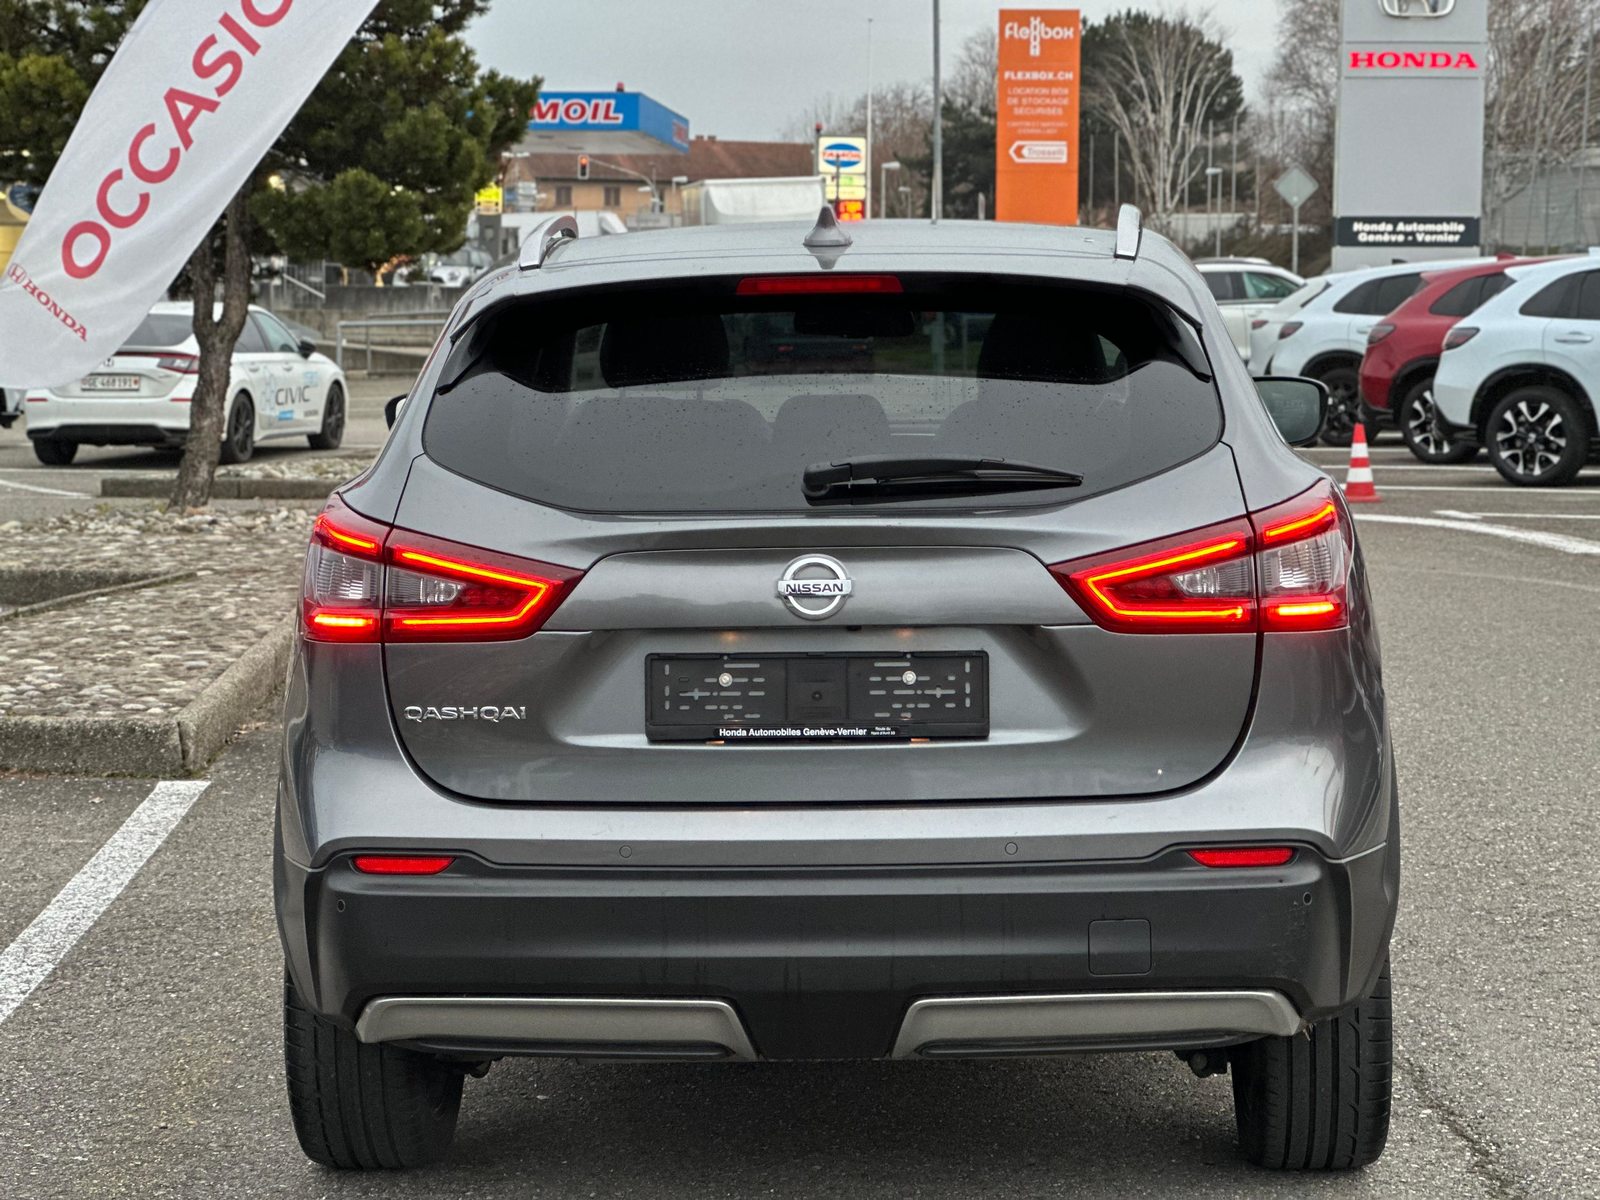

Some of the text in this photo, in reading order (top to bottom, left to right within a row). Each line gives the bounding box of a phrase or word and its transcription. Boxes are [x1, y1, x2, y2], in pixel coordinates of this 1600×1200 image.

[1349, 51, 1478, 70] HONDA
[1004, 70, 1074, 81] FLEXBOX.CH
[1352, 221, 1466, 233] Honda Automobile
[1357, 232, 1405, 243] Genève
[1415, 232, 1461, 243] Vernier
[22, 279, 87, 342] HONDA
[275, 385, 311, 406] CIVIC
[785, 583, 844, 593] NISSAN
[404, 705, 527, 723] QASHQAI
[719, 727, 868, 737] Honda Automobiles Genève-Vernier
